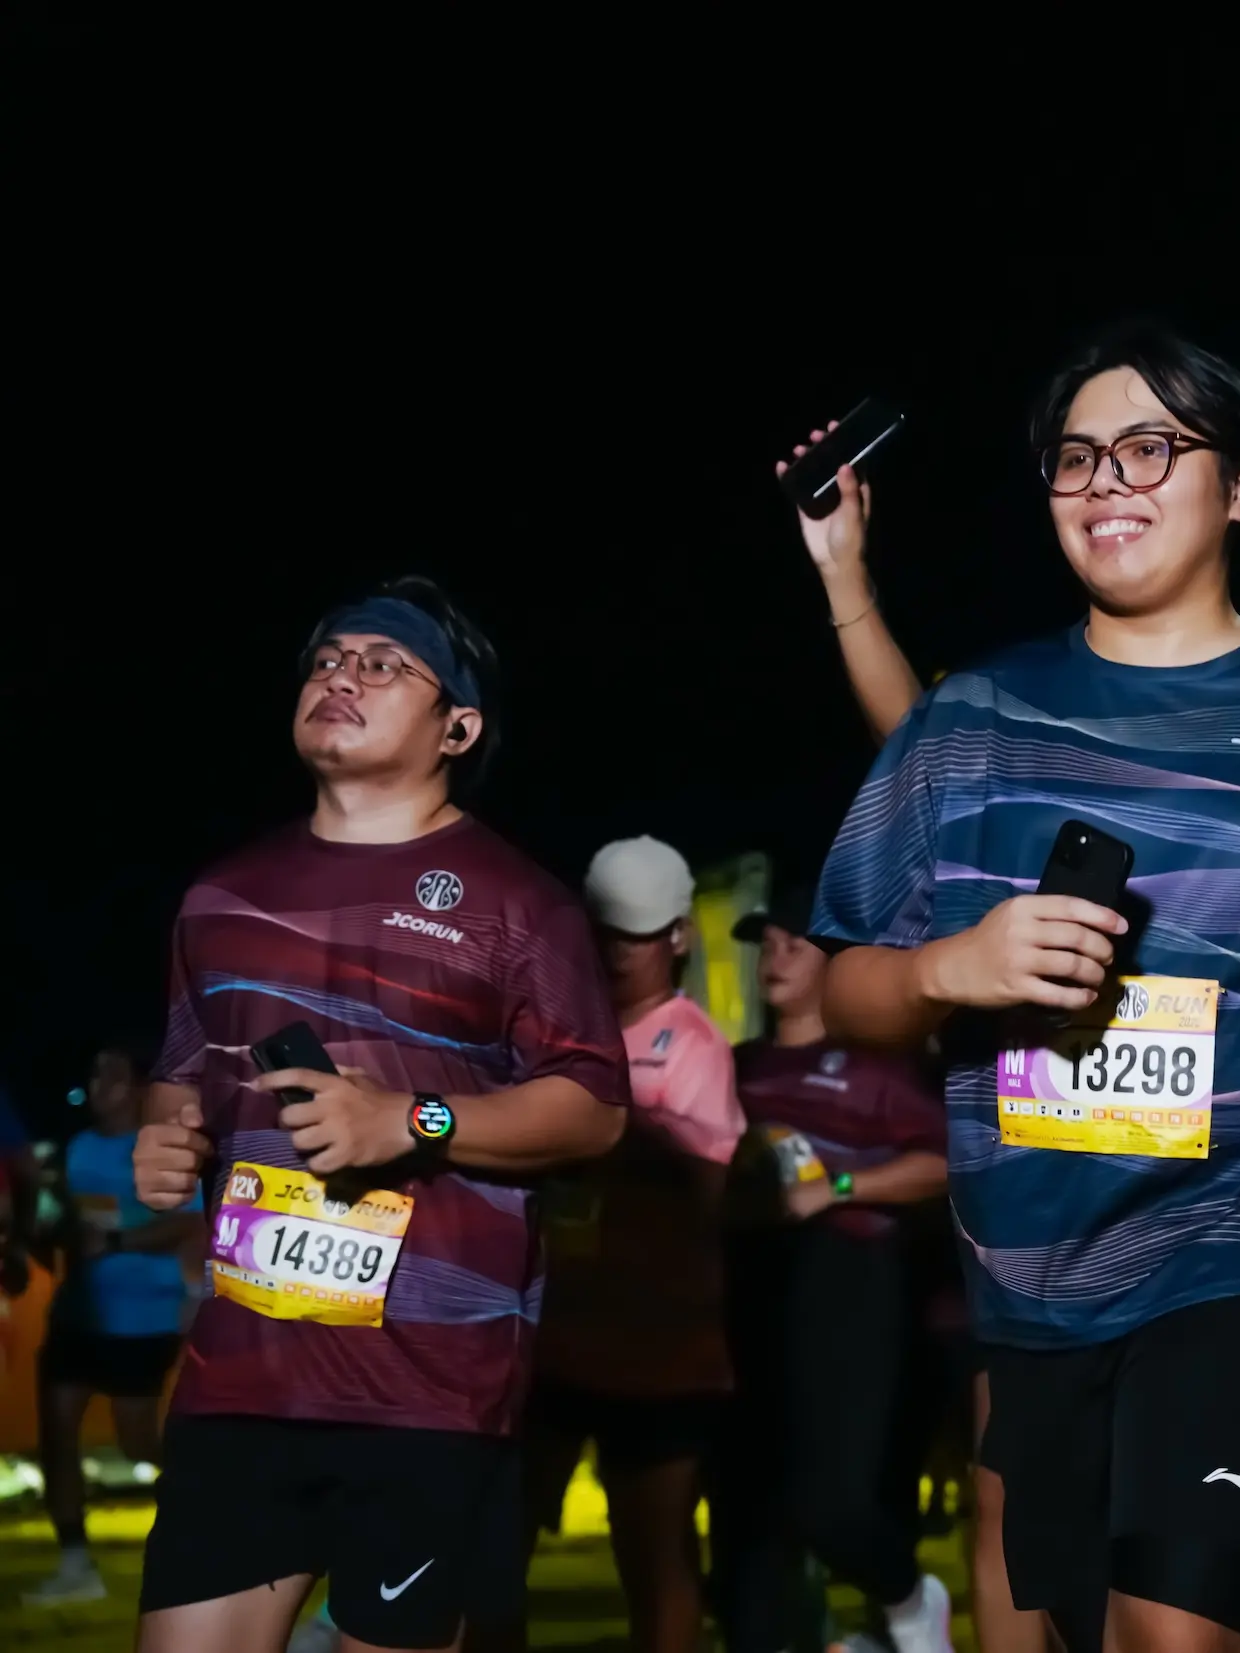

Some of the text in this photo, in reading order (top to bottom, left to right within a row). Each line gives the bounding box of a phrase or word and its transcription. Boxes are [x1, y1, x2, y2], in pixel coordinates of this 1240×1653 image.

[382, 911, 464, 944] JCORUN
[1154, 994, 1209, 1015] RUN
[1005, 1049, 1025, 1075] M
[1071, 1042, 1197, 1097] 13298
[230, 1175, 259, 1201] 12K
[274, 1184, 404, 1220] JCO RUN
[217, 1215, 240, 1247] M
[270, 1225, 384, 1284] 14389
